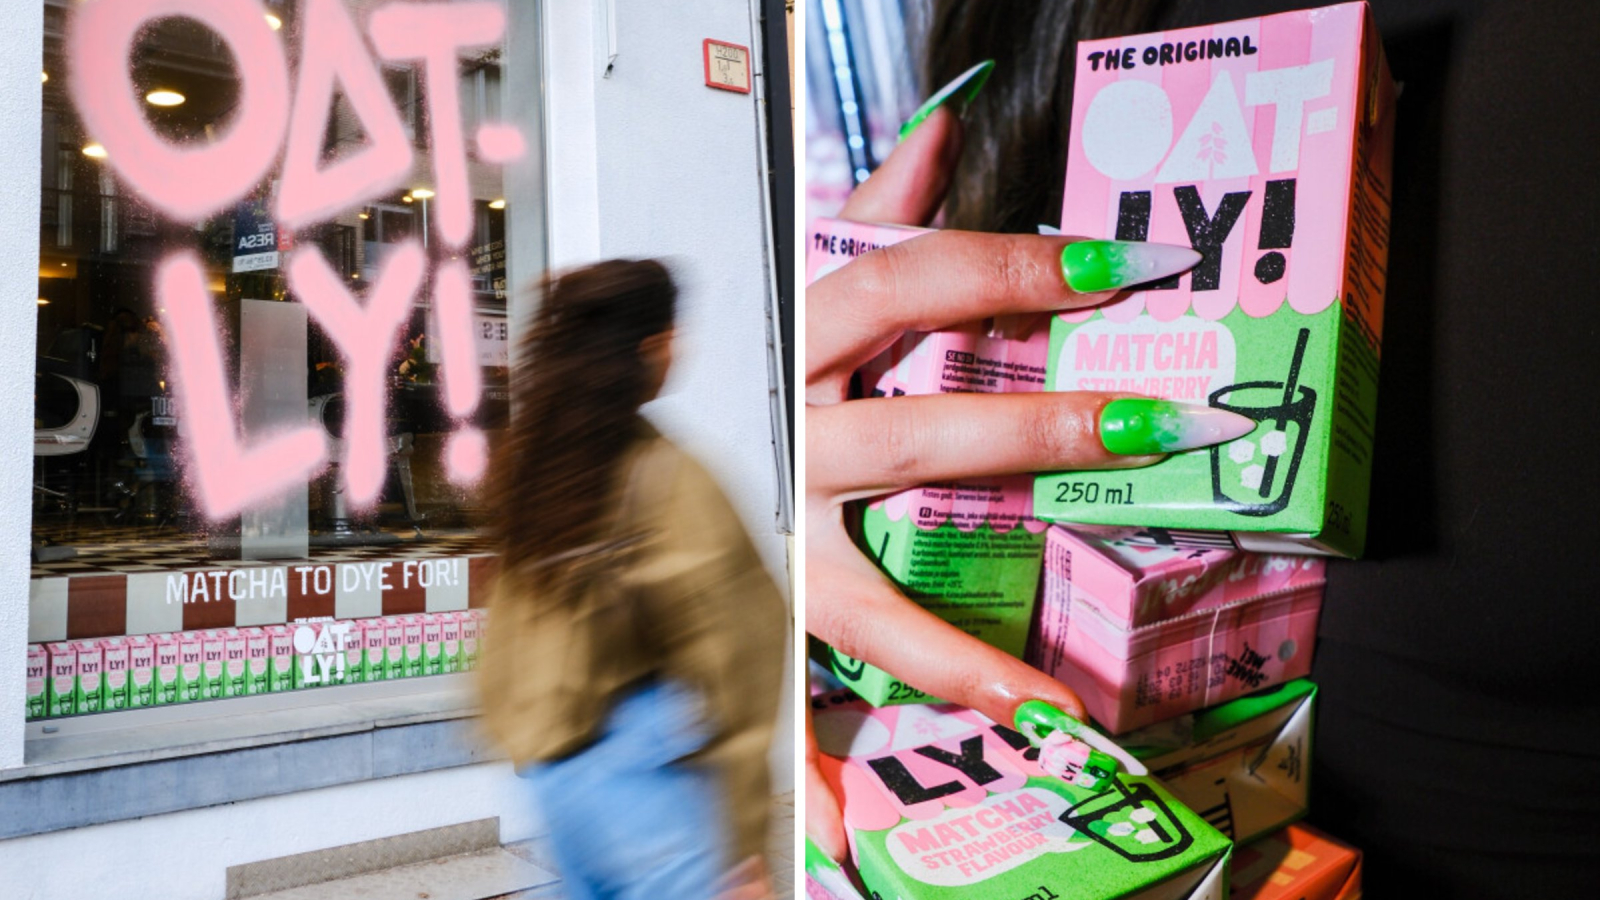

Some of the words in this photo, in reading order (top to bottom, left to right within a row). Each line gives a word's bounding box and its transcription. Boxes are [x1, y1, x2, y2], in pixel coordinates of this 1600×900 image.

[1087, 48, 1136, 71] THE
[1142, 35, 1258, 66] ORIGINAL
[1082, 58, 1338, 184] OAT-
[814, 232, 837, 254] THE
[840, 238, 886, 257] ORIGI
[1075, 330, 1219, 372] MATCHA
[155, 238, 489, 520] LY!
[1076, 374, 1212, 399] STRAWBERRY
[1055, 482, 1099, 504] 250
[1105, 482, 1135, 505] ml
[166, 568, 287, 604] MATCHA
[295, 566, 332, 595] TO
[342, 562, 394, 593] DYE
[402, 558, 460, 589] FOR!
[389, 636, 401, 646] LY!
[407, 635, 420, 644] LY!
[427, 632, 439, 642] LY!
[446, 631, 458, 640] LY!
[369, 638, 382, 647] LY!
[207, 651, 221, 661] LY!
[229, 650, 243, 659] LY!
[251, 647, 265, 657] LY!
[276, 646, 290, 655] LY!
[135, 657, 151, 668] LY!
[161, 655, 176, 665] LY!
[184, 653, 199, 663] LY!
[56, 665, 73, 676] LY!
[82, 662, 98, 673] LY!
[109, 660, 125, 670] LY!
[304, 653, 345, 683] LY!
[867, 723, 1040, 806] LY!
[1061, 762, 1083, 781] LY!
[896, 792, 1049, 855] MATCHA
[920, 809, 1062, 871] STRAWBERRY
[956, 833, 1050, 878] FLAVOUR
